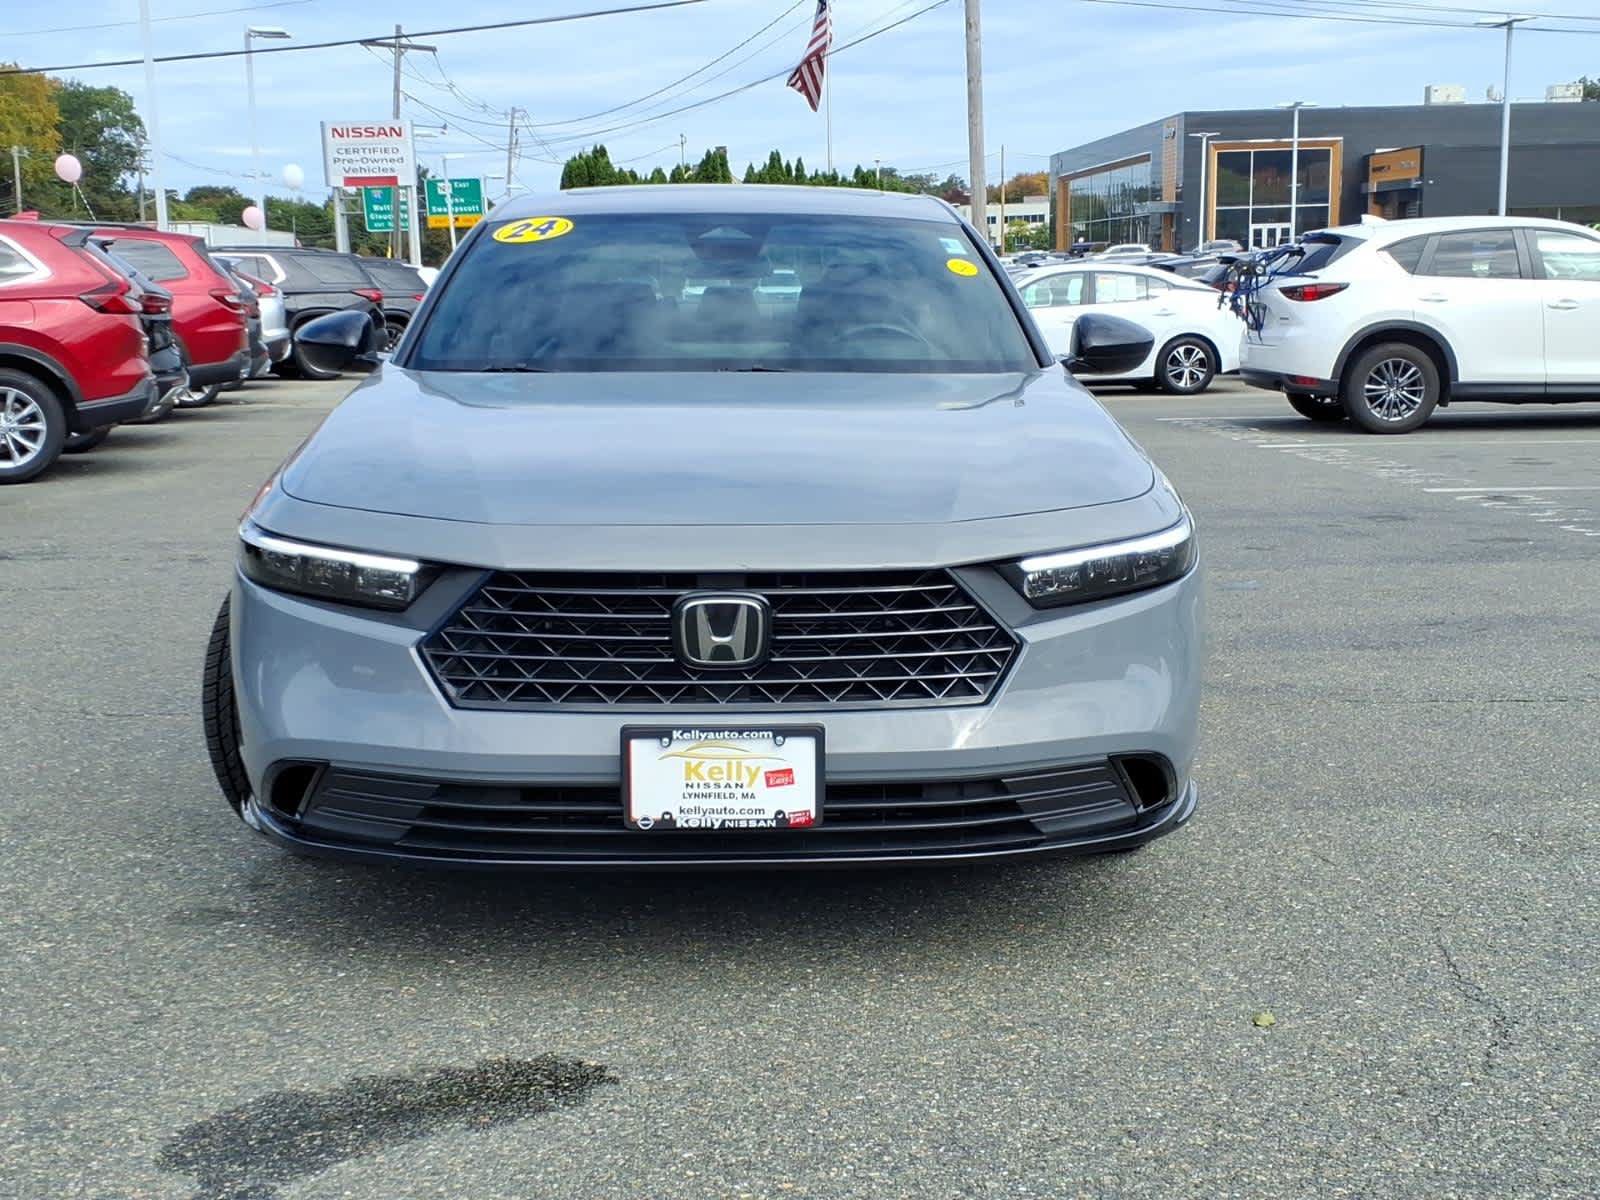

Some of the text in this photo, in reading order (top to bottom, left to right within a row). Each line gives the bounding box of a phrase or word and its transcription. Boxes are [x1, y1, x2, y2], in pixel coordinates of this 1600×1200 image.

[331, 126, 403, 138] NISSAN
[336, 146, 400, 155] CERTIFIED
[333, 156, 405, 165] Pre-Owned
[343, 166, 396, 174] Vehicles
[502, 219, 559, 240] 24
[672, 729, 773, 741] Kellyauto.com
[684, 761, 761, 788] Kelly
[682, 792, 738, 800] LYNNFIELD,
[679, 805, 766, 817] kellyauto.com
[675, 816, 777, 829] Kelly NISSAN
